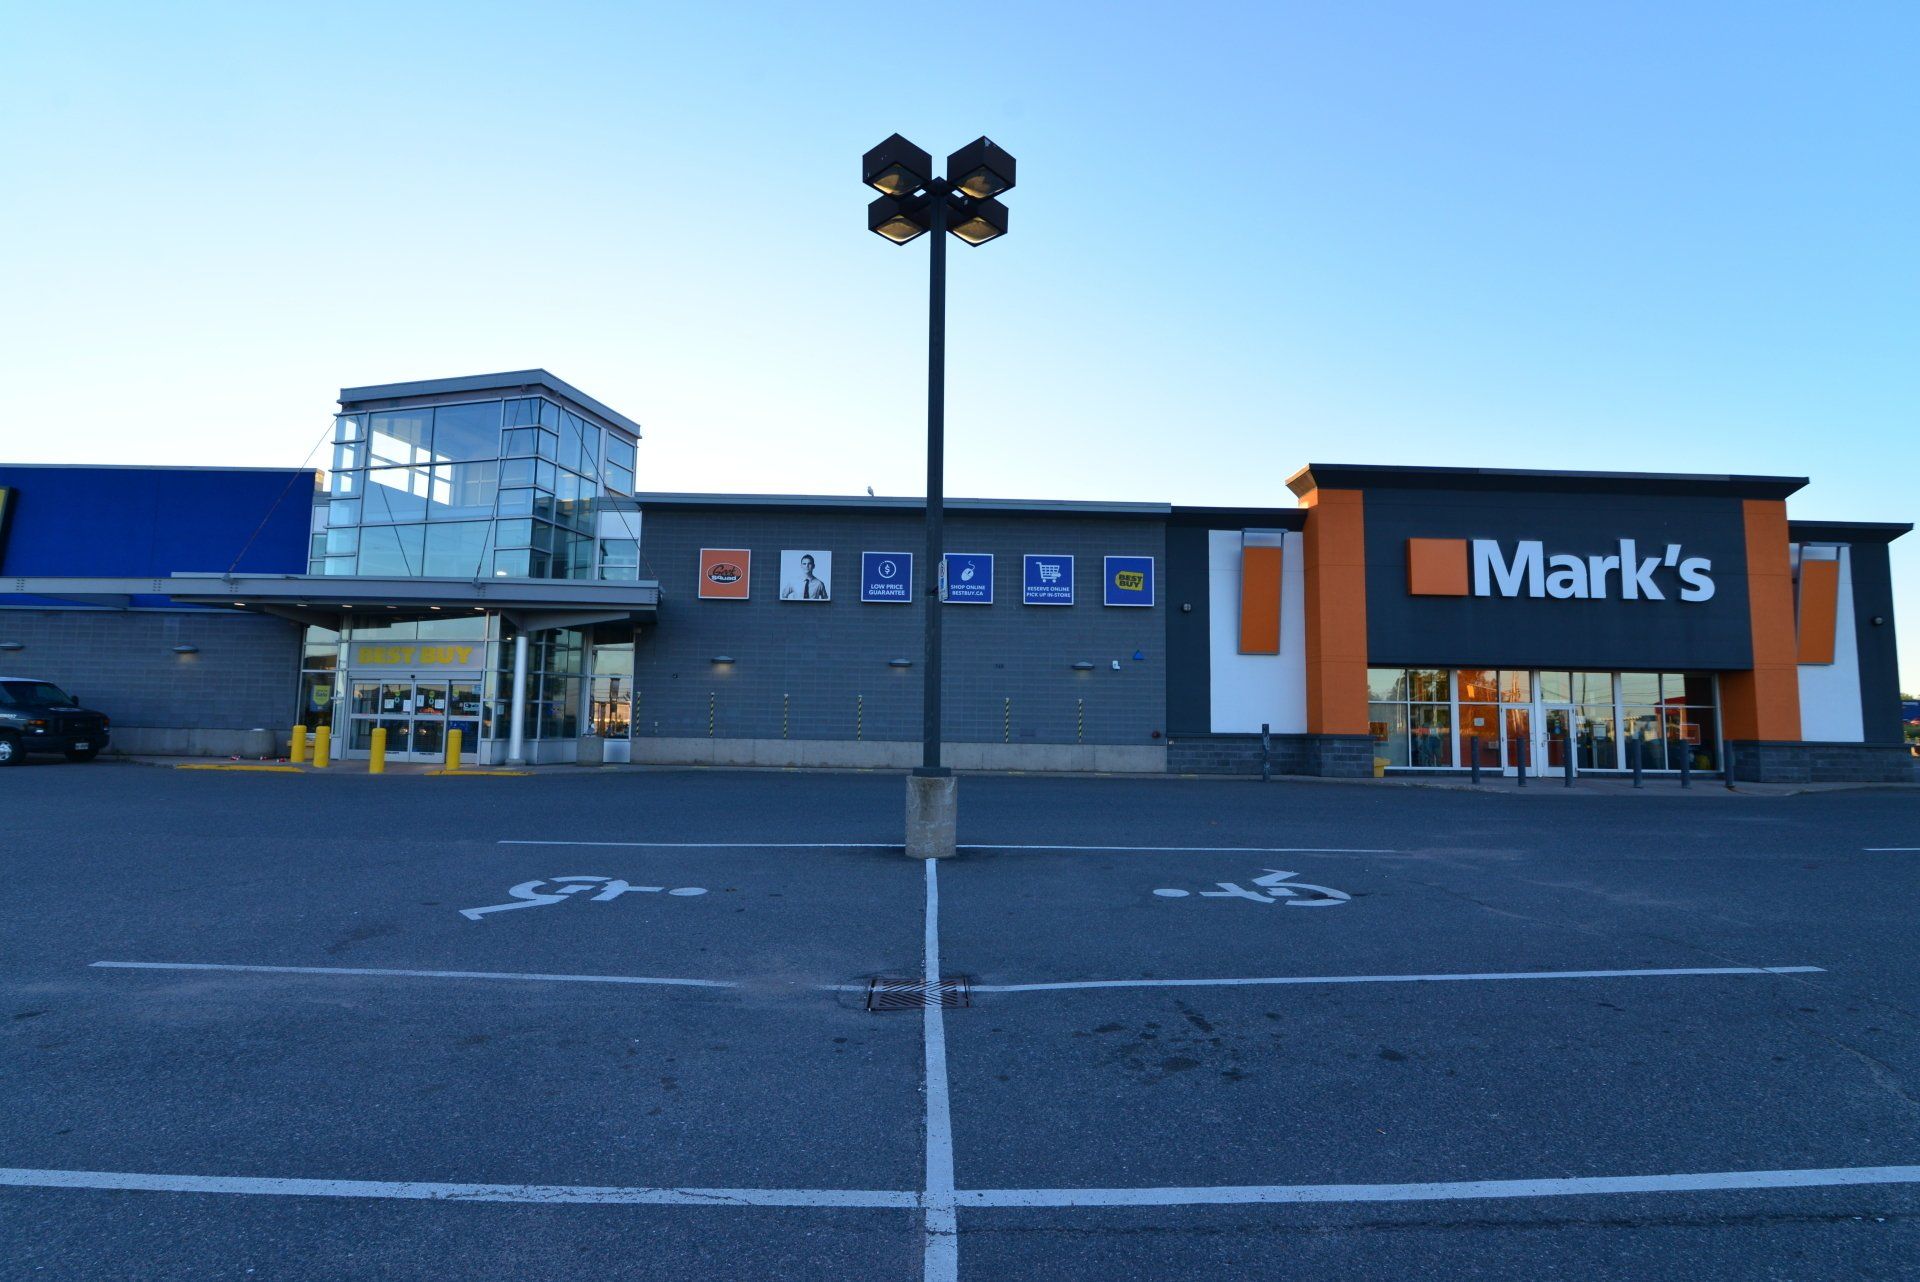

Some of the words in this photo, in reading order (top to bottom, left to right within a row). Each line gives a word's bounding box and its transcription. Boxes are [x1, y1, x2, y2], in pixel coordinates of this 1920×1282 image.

[1118, 574, 1143, 582] BEST
[1472, 538, 1716, 602] Mark's
[358, 646, 415, 665] BEST
[420, 645, 472, 664] BUY
